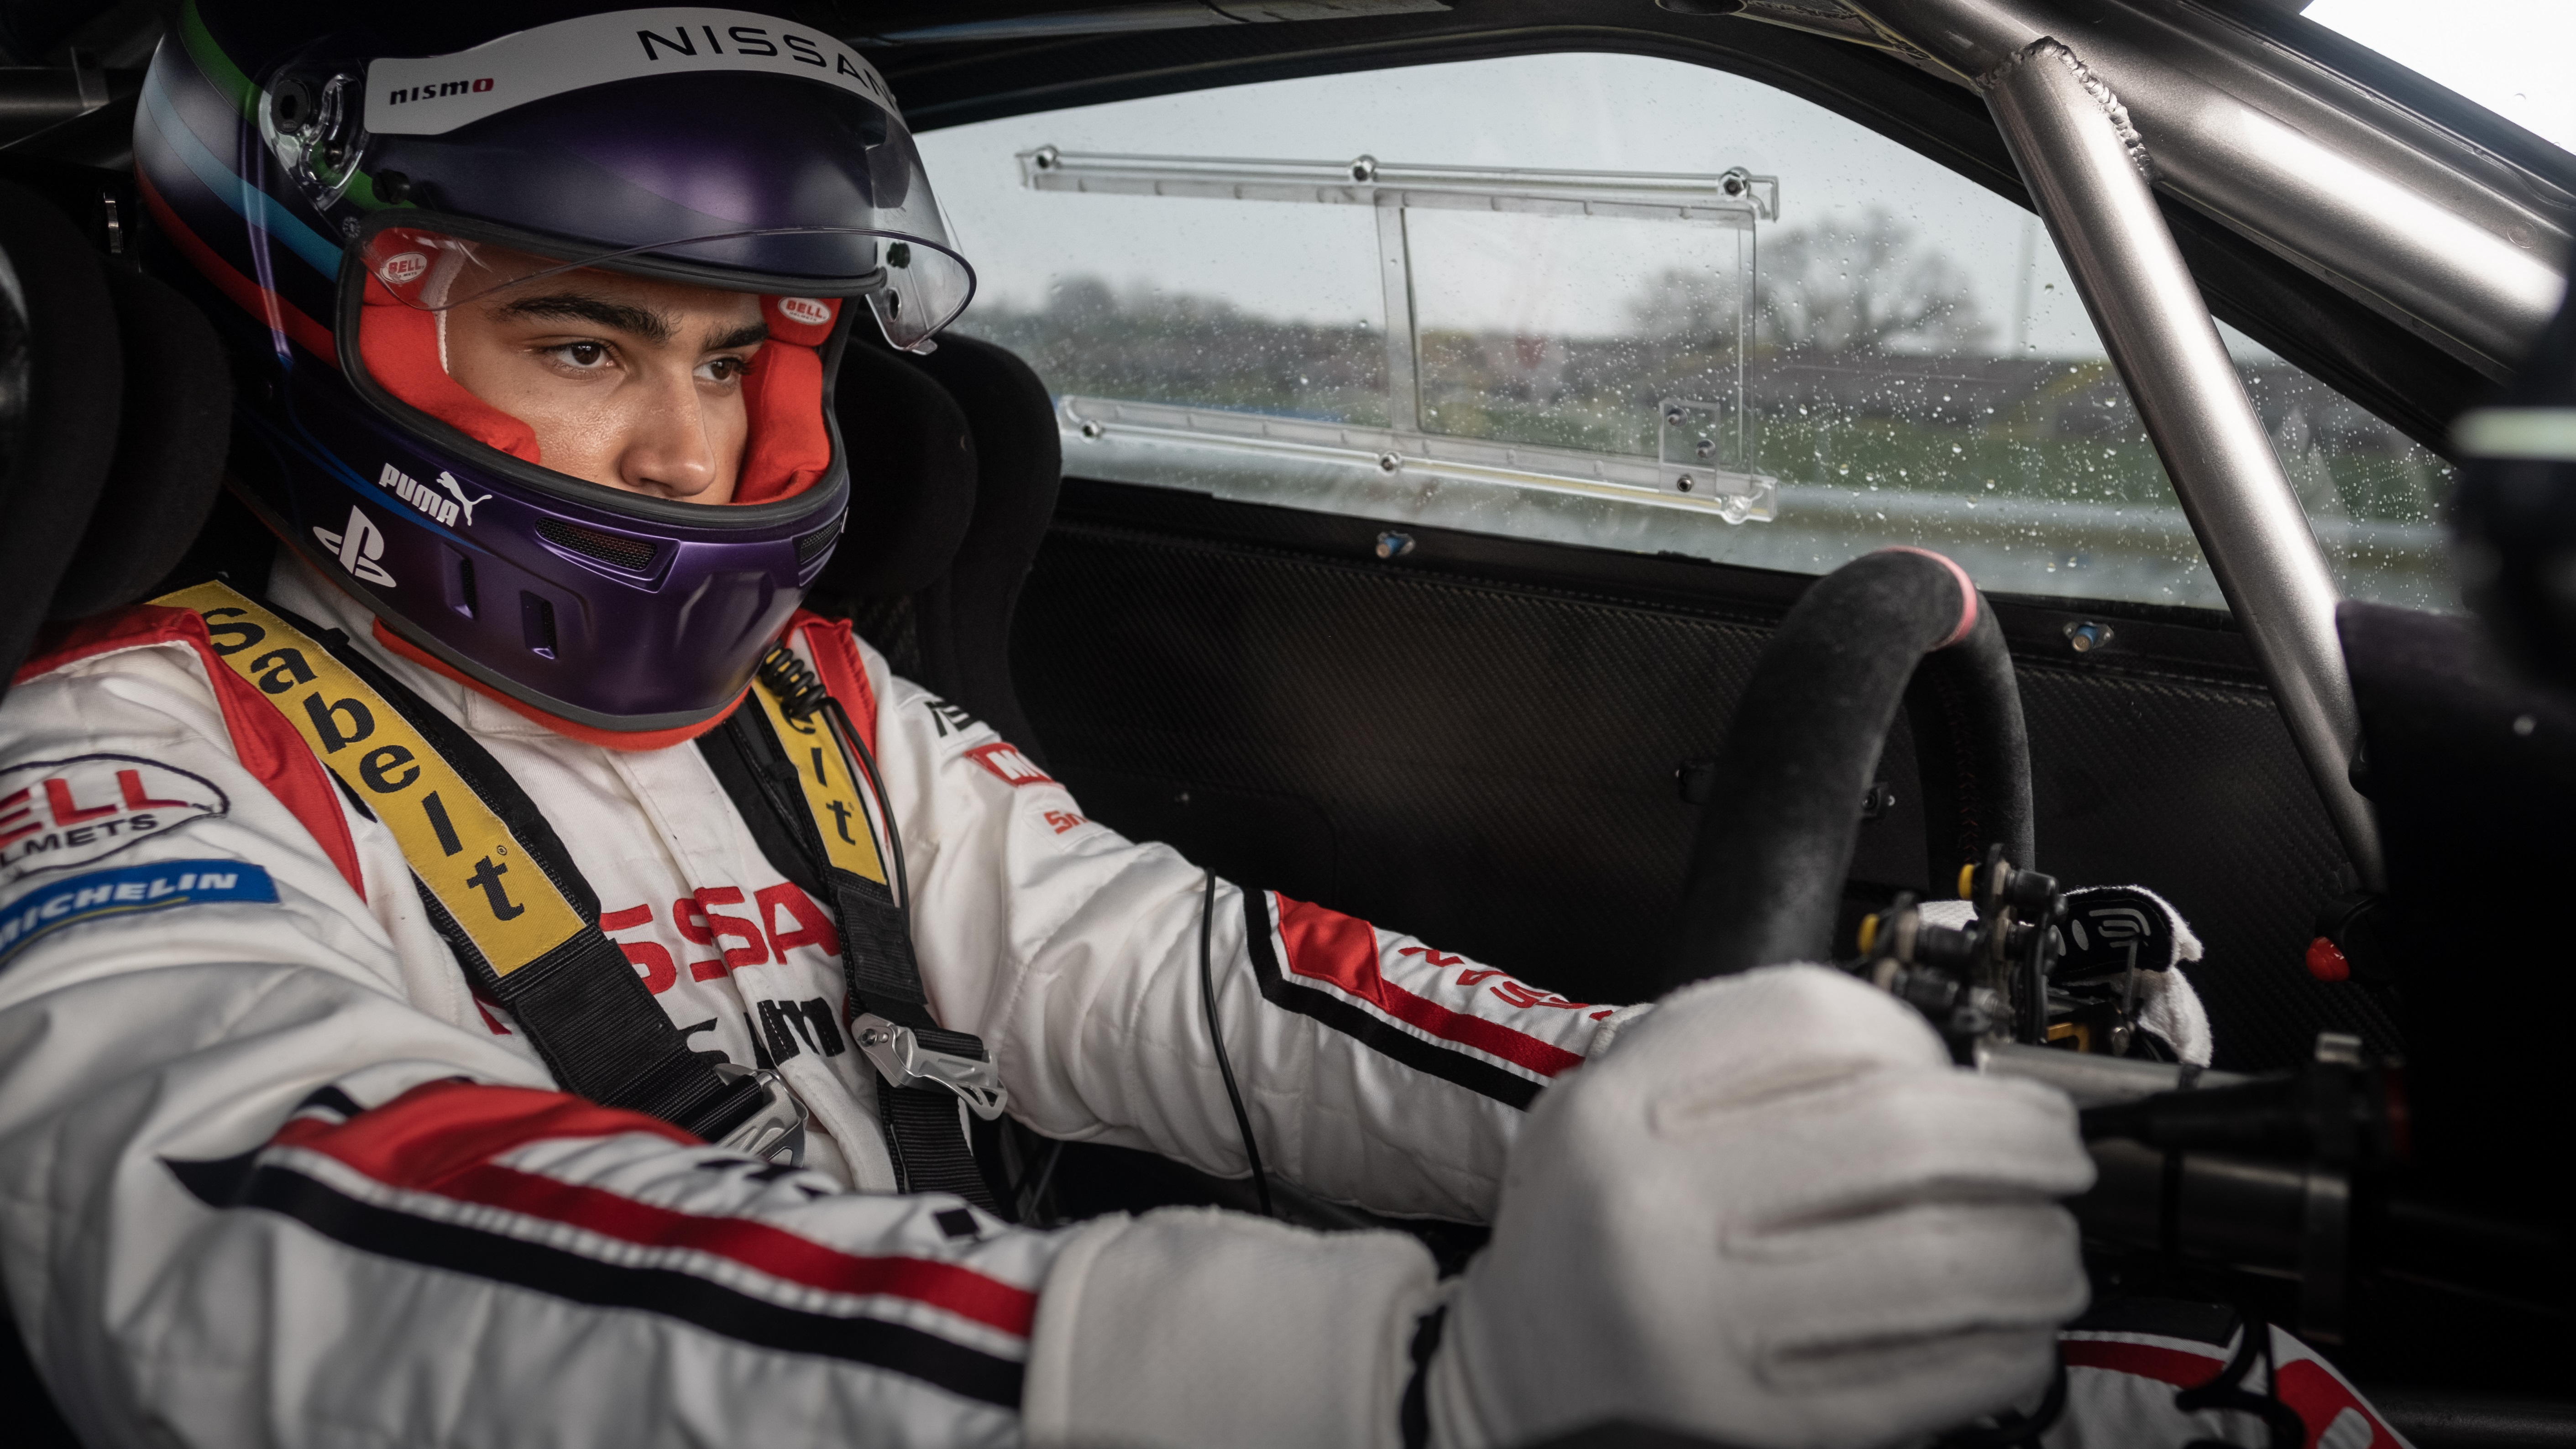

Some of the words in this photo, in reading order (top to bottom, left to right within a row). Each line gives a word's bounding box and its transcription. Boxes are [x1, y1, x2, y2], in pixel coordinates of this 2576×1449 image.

[390, 78, 494, 105] nismo
[636, 25, 897, 112] NISSAN
[388, 258, 421, 274] BELL
[786, 299, 822, 318] BELL
[379, 463, 460, 527] PUMA
[0, 769, 188, 850] ELL
[0, 814, 157, 868] LMETS
